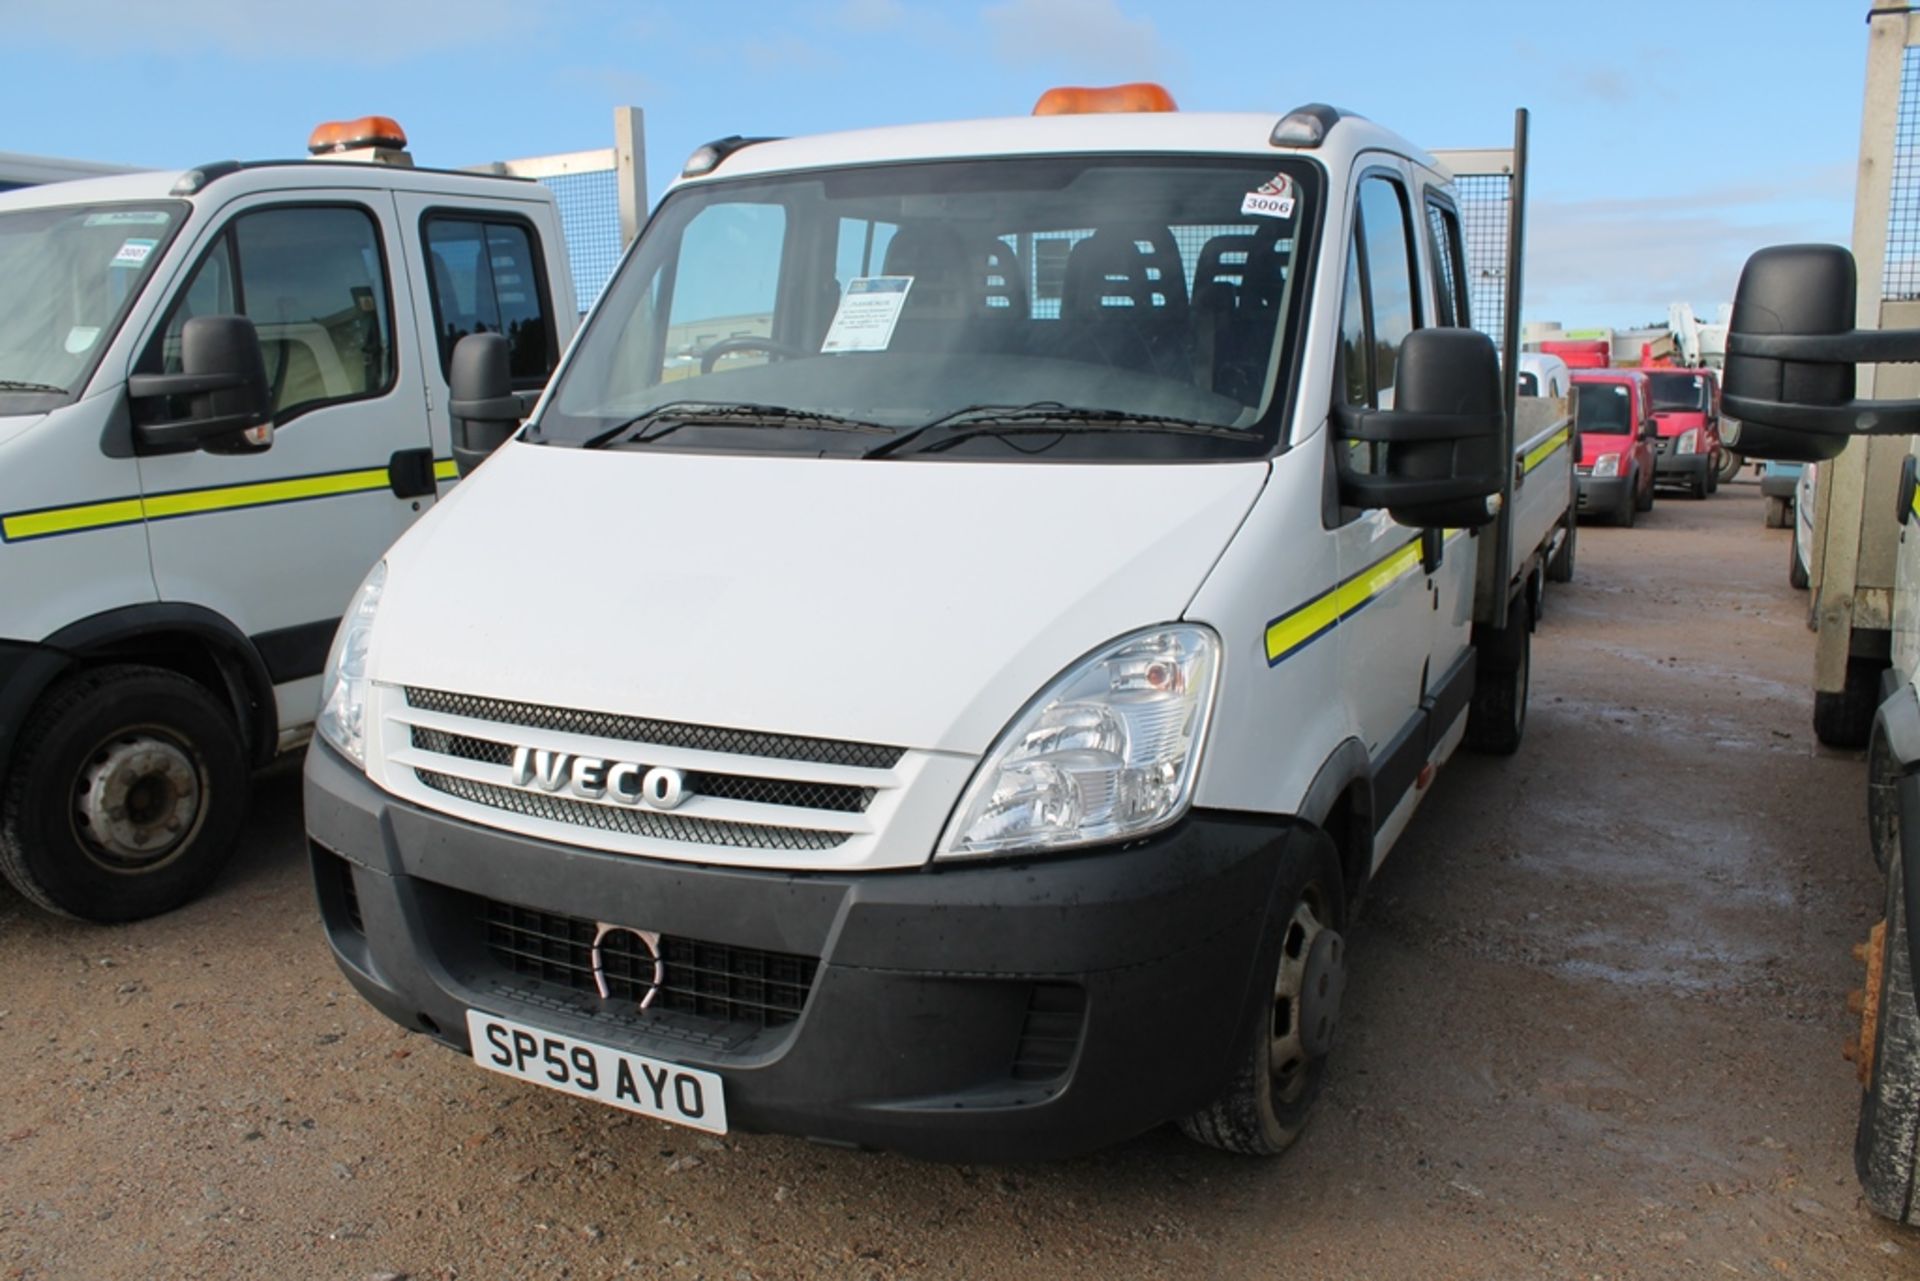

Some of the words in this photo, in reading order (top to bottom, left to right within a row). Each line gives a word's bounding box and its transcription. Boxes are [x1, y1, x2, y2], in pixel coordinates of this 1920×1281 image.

[1246, 197, 1290, 213] 3006
[512, 746, 685, 810] IVECO
[486, 1022, 600, 1092] SP59
[615, 1058, 705, 1120] AYO
